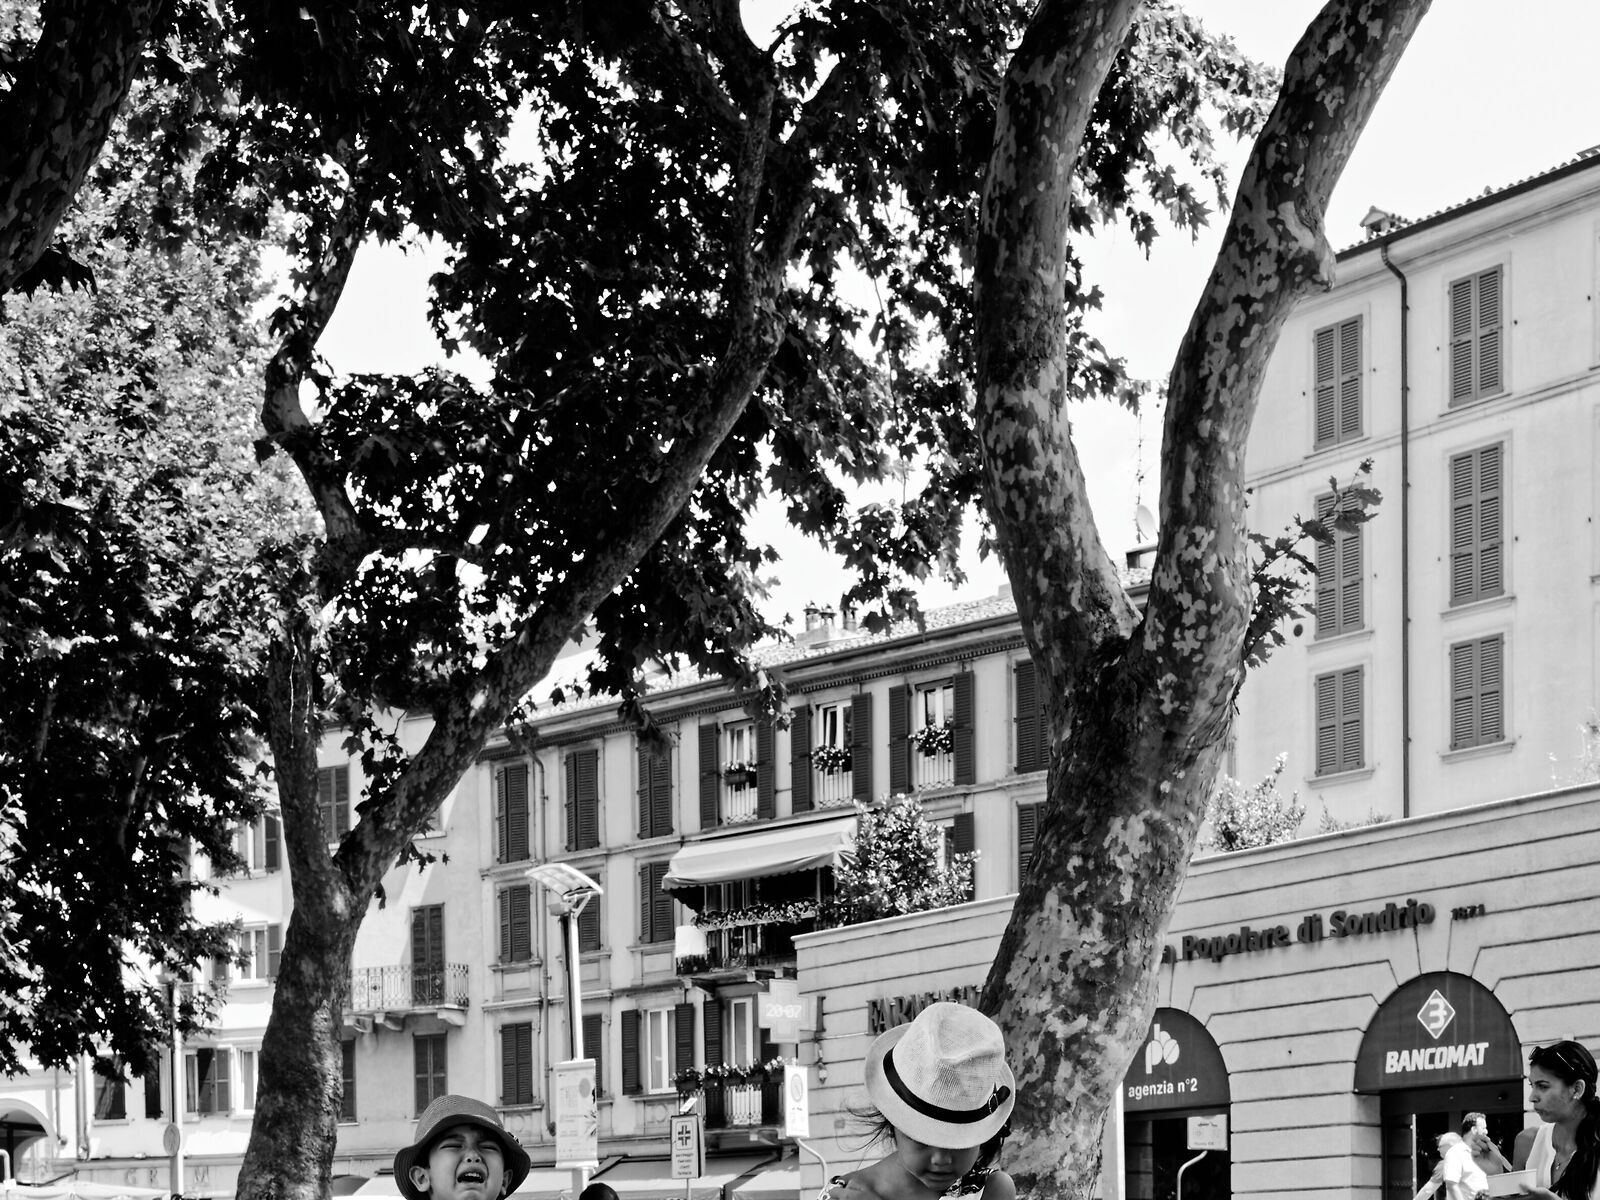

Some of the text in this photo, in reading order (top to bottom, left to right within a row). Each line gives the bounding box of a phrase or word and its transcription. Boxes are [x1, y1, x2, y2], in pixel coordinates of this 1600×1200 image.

[1182, 924, 1292, 963] Popolare
[1297, 913, 1323, 943] di
[1330, 898, 1435, 938] Sondrio
[1450, 903, 1486, 921] 1871
[1385, 1042, 1489, 1074] BANCOMAT
[1128, 1077, 1198, 1100] agenzia n°2
